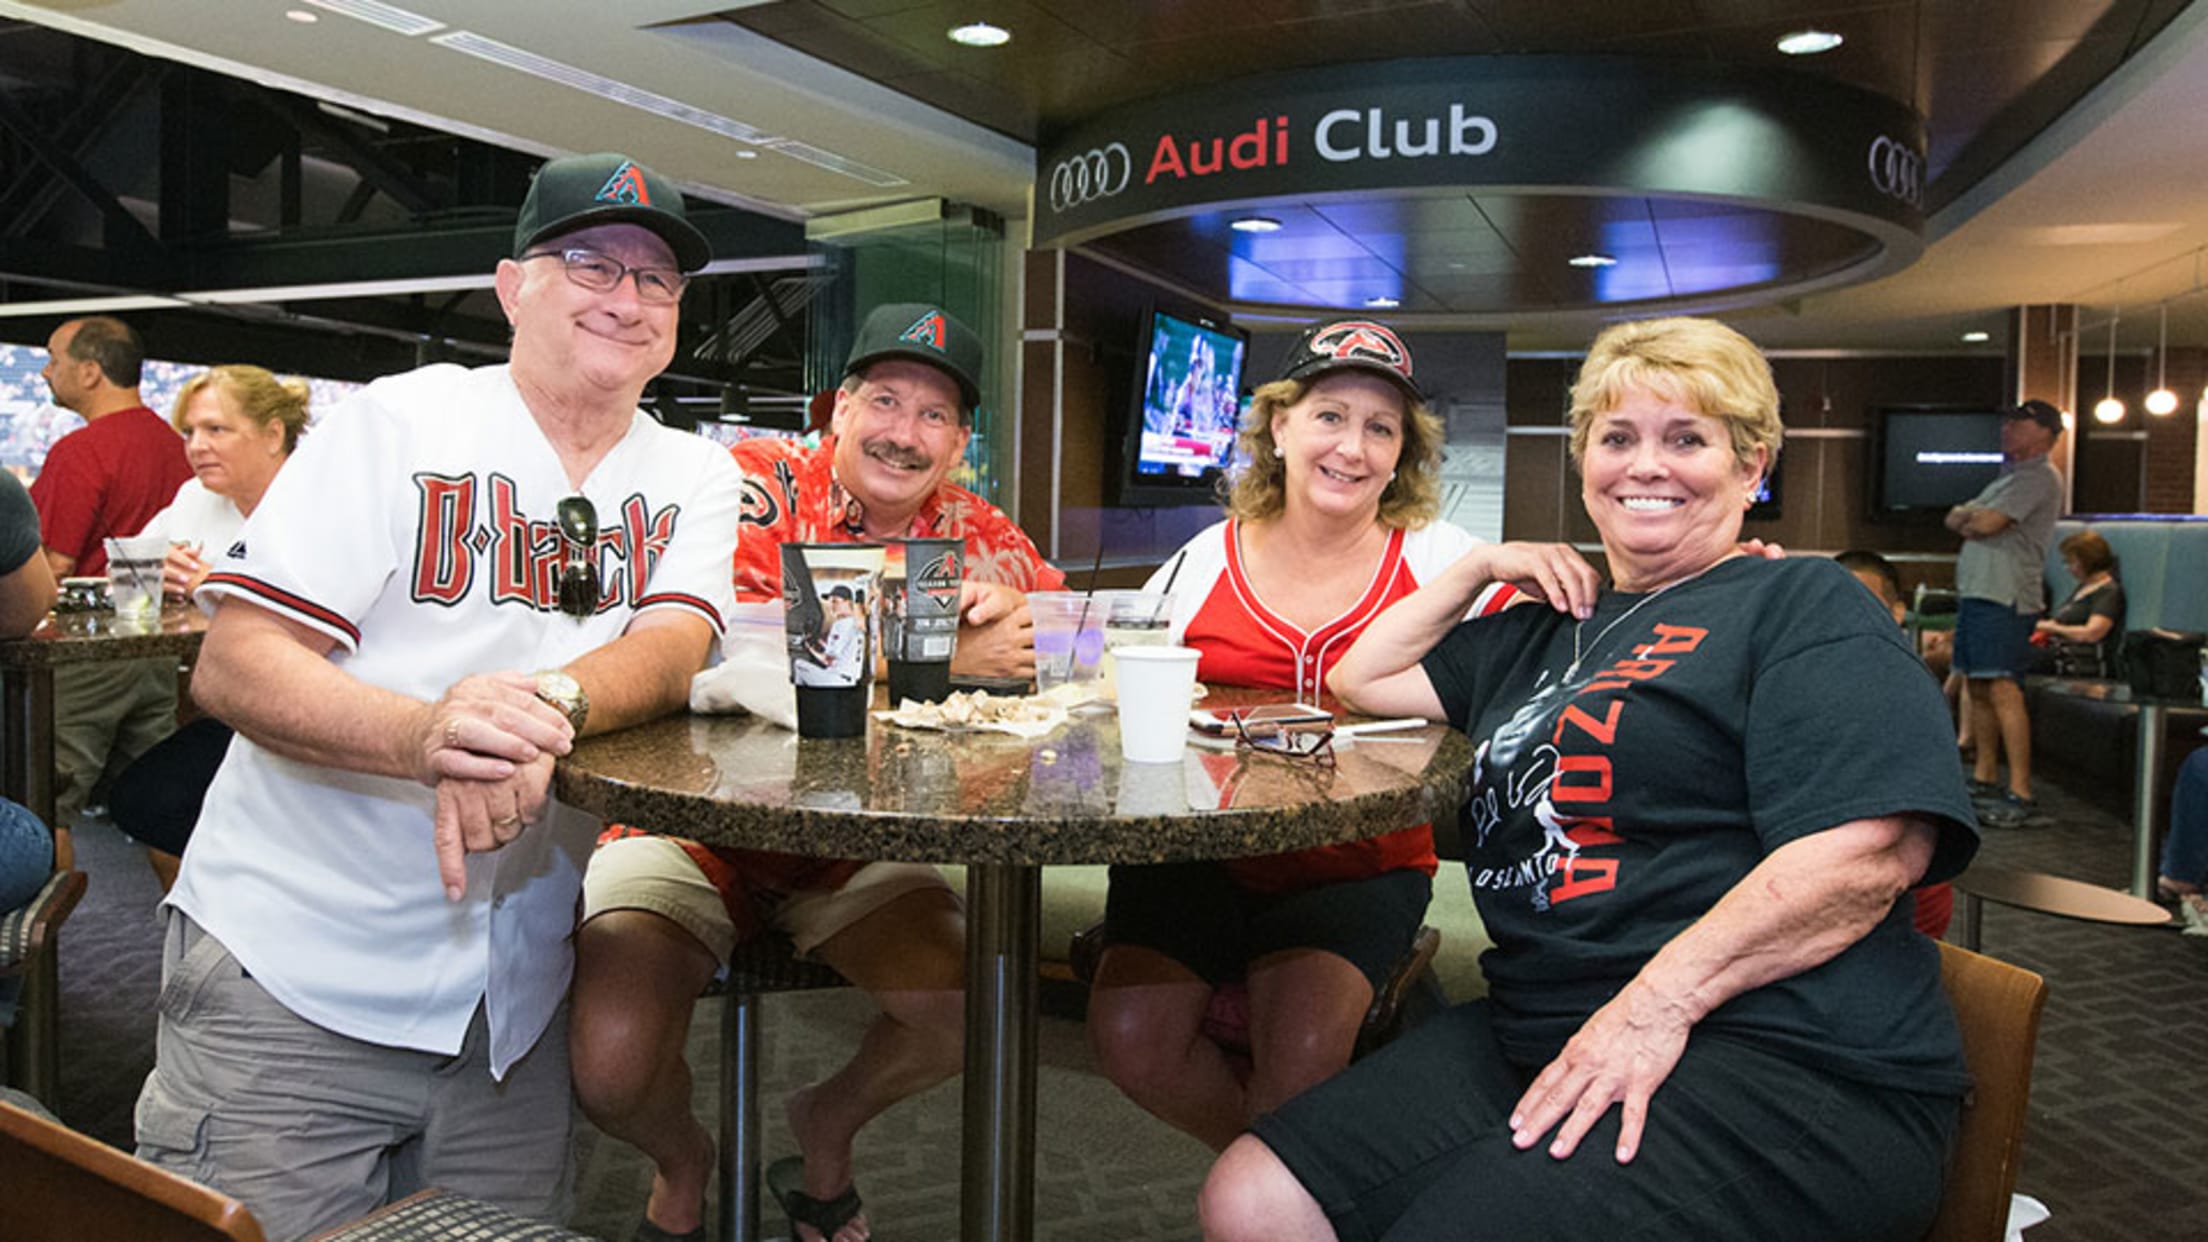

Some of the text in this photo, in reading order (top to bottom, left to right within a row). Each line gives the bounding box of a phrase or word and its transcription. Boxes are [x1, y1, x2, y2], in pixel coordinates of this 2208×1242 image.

[1145, 104, 1498, 184] Audi Club
[1550, 622, 1710, 905] ARIZONA
